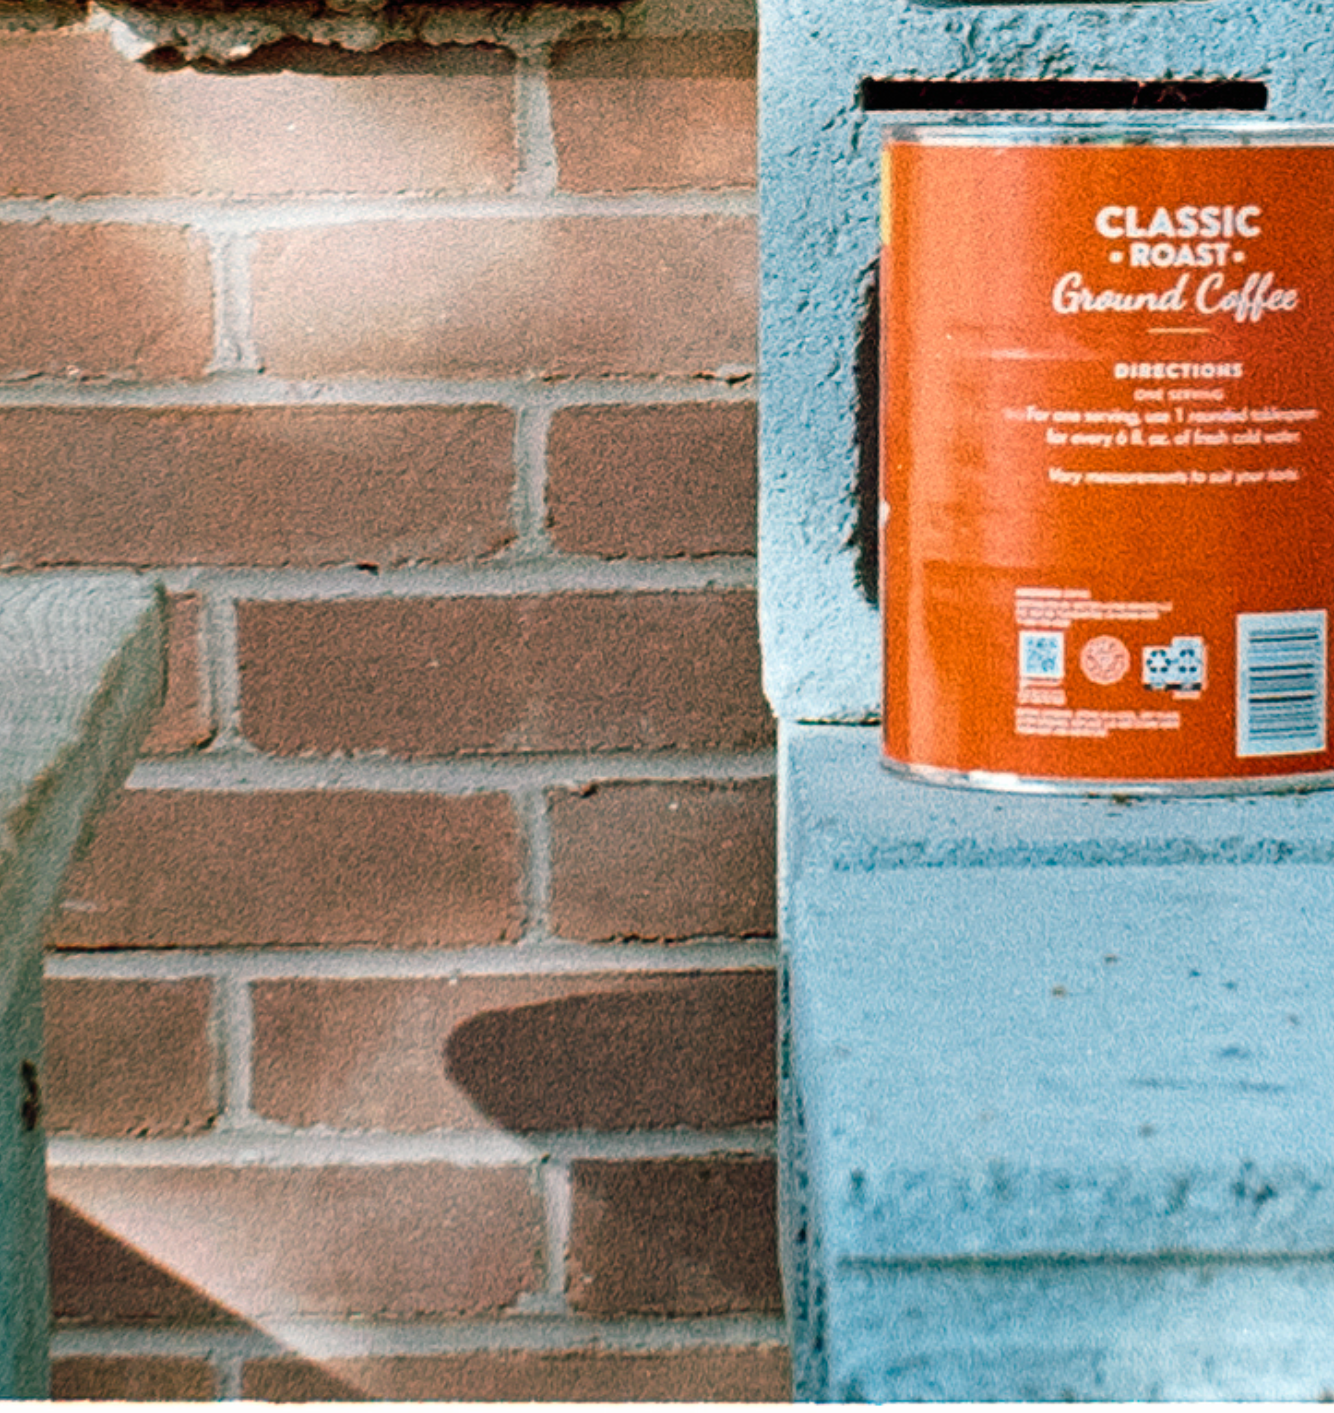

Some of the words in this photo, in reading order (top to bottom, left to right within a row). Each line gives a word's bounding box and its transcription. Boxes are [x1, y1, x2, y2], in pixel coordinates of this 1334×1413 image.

[1095, 205, 1262, 238] CLASSIC
[1129, 242, 1230, 267] ROAST
[1051, 271, 1190, 314] Ground
[1195, 271, 1299, 323] Coffee
[1114, 362, 1244, 379] DIRECTIONS
